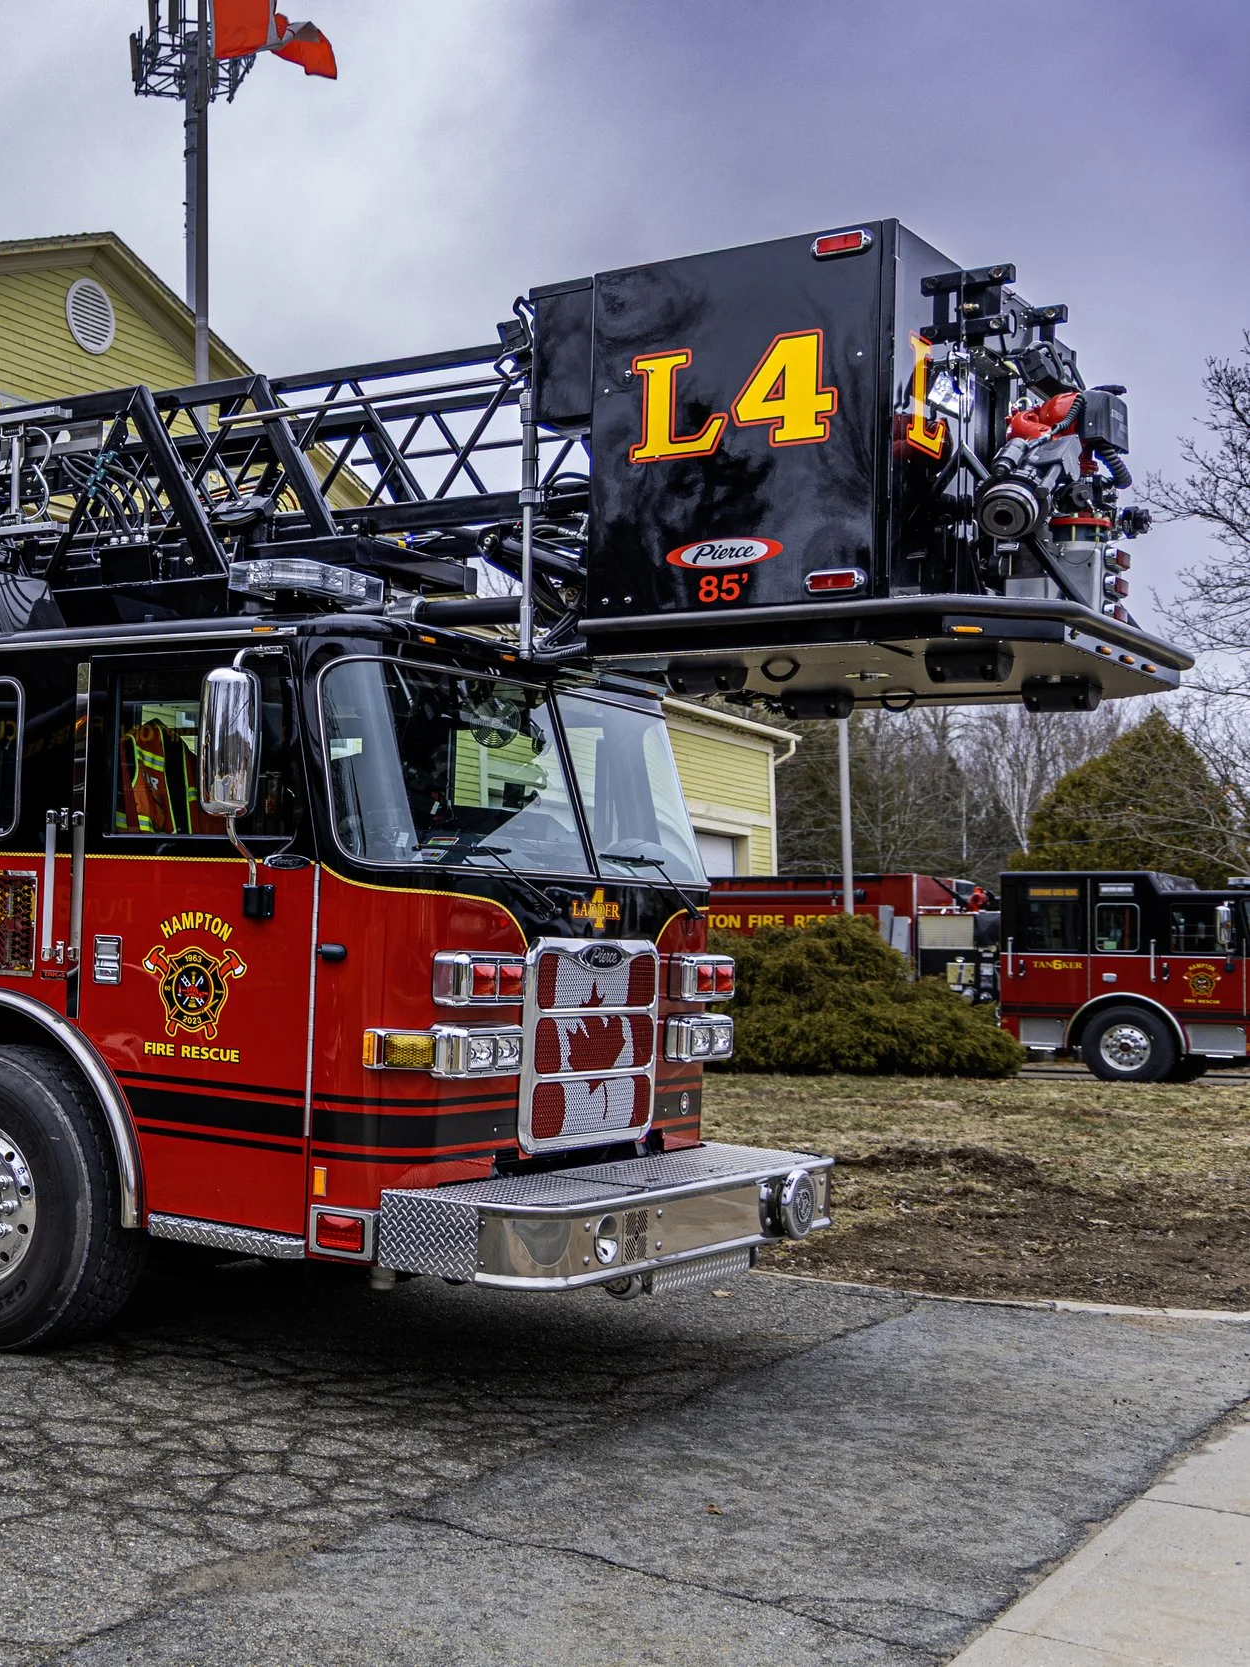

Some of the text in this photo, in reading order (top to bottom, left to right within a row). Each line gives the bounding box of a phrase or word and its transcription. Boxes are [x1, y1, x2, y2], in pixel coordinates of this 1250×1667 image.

[630, 328, 838, 464] L4
[692, 544, 755, 564] Pierce
[572, 901, 620, 919] LADDER
[160, 911, 233, 942] HAMPTON
[748, 914, 785, 928] FIRE
[184, 954, 202, 963] 1963
[591, 947, 618, 964] Pierce
[182, 1015, 202, 1024] 2023
[144, 1041, 240, 1063] FIRE RESCUE
